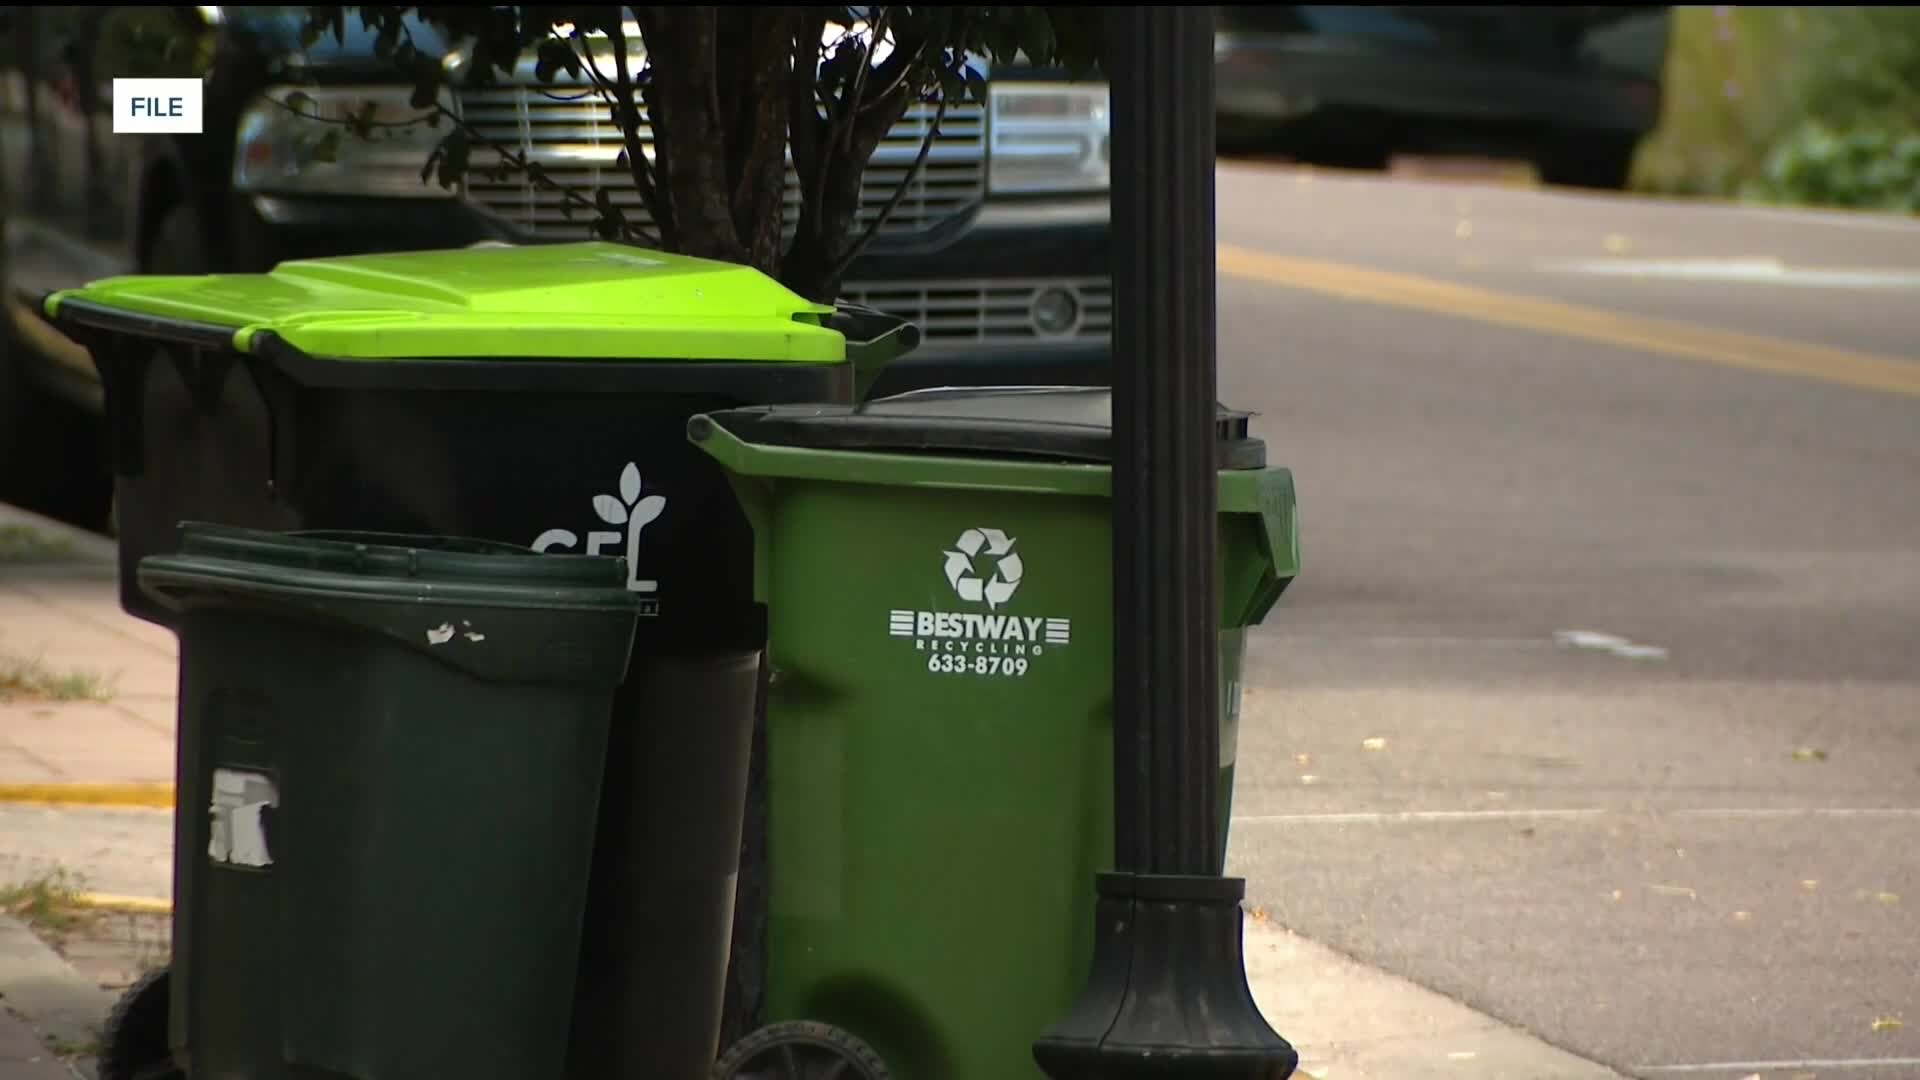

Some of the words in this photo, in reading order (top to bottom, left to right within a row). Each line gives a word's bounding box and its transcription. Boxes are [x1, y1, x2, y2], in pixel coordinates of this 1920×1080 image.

[916, 611, 1043, 641] BESTWAY
[916, 639, 1043, 656] RECYCLING
[928, 654, 1028, 676] 633-8709
